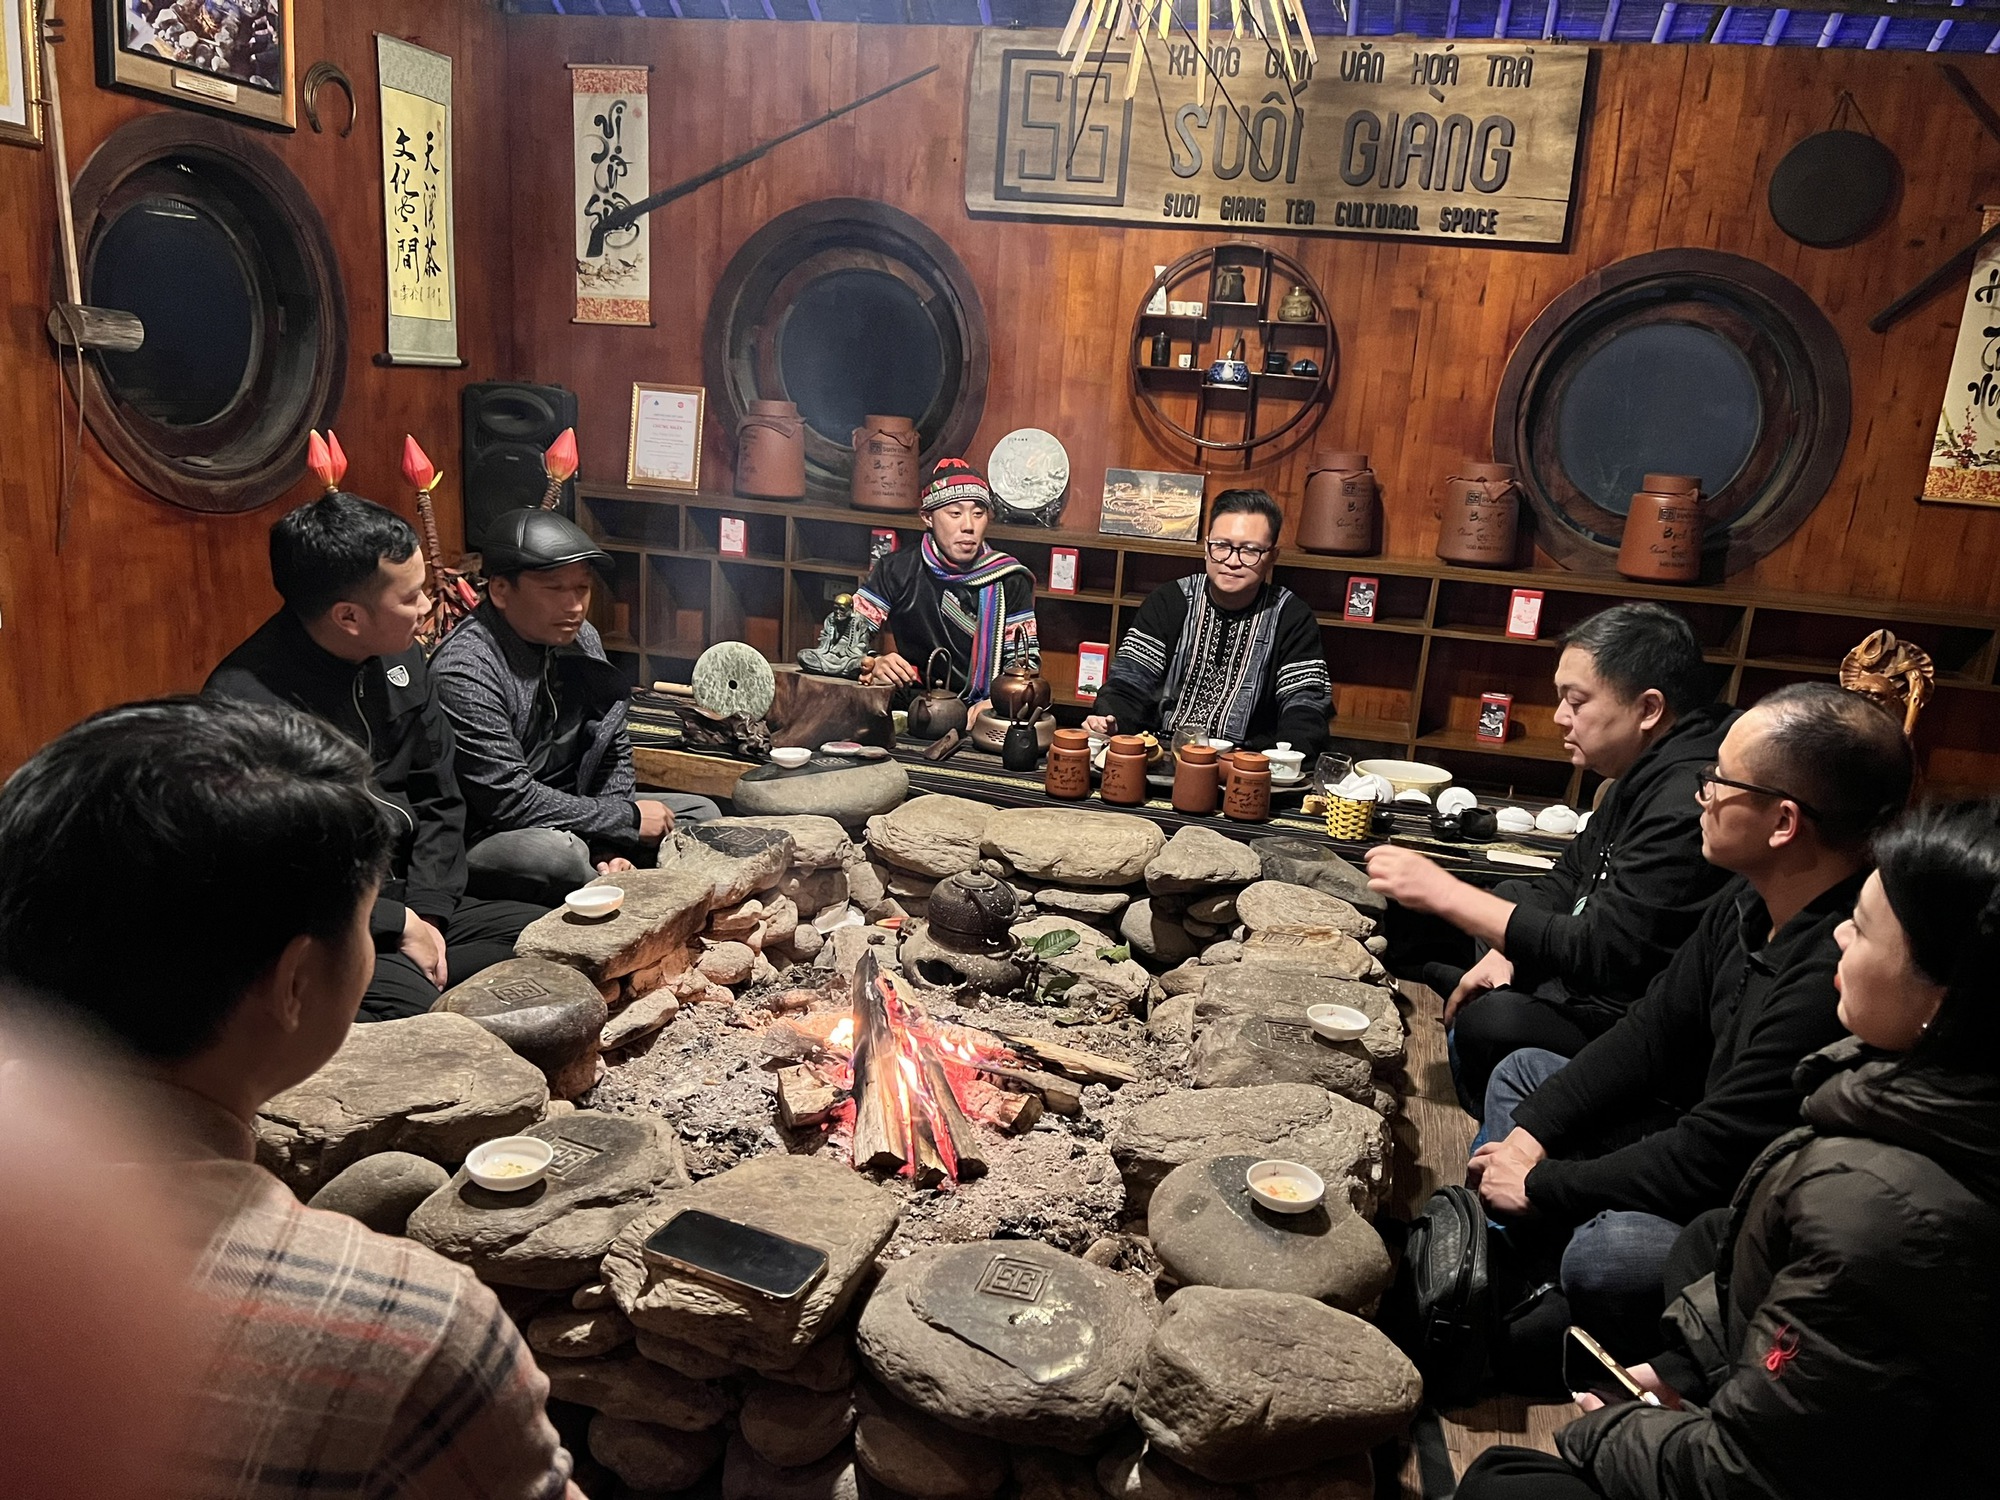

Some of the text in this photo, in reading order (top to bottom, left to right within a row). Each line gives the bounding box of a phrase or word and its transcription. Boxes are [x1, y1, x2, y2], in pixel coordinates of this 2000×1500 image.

[1340, 43, 1385, 84] VĂN
[1411, 44, 1459, 86] HOÁ
[1486, 46, 1535, 88] TRÀ
[1170, 79, 1516, 194] SUỐI GIÀNG
[1163, 193, 1500, 235] SUOI GIANG TEA CULTURAL SPACE
